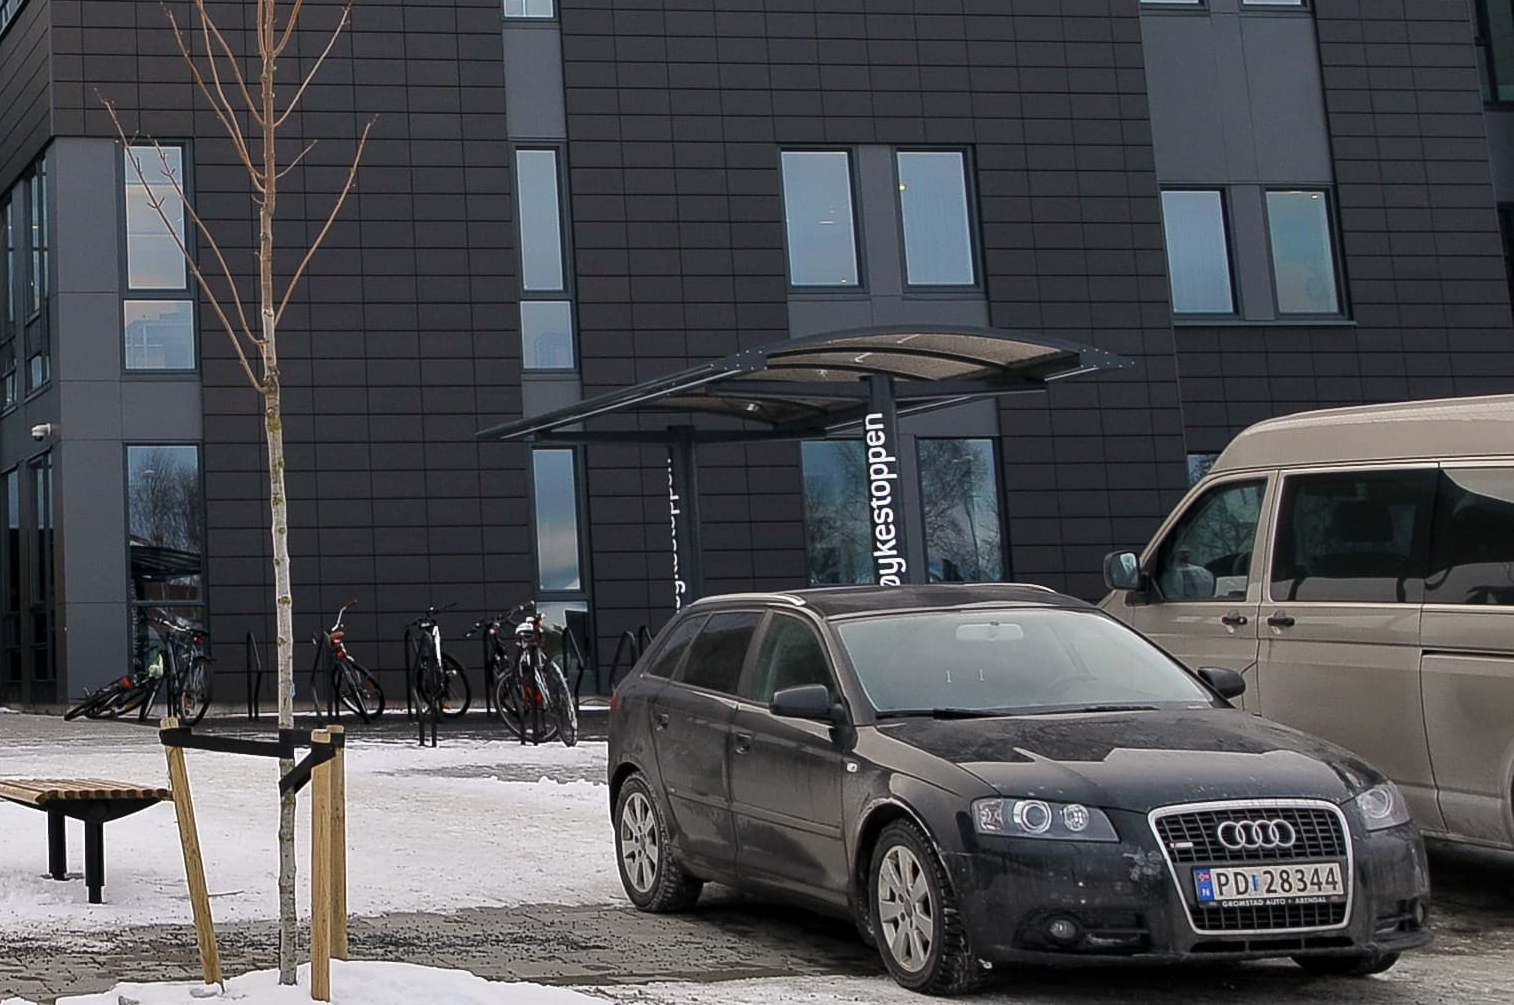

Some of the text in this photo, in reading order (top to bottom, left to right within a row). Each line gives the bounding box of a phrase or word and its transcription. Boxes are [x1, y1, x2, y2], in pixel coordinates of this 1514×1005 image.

[1216, 871, 1249, 896] PD
[1263, 867, 1338, 894] 28344
[1265, 898, 1286, 906] AUTO
